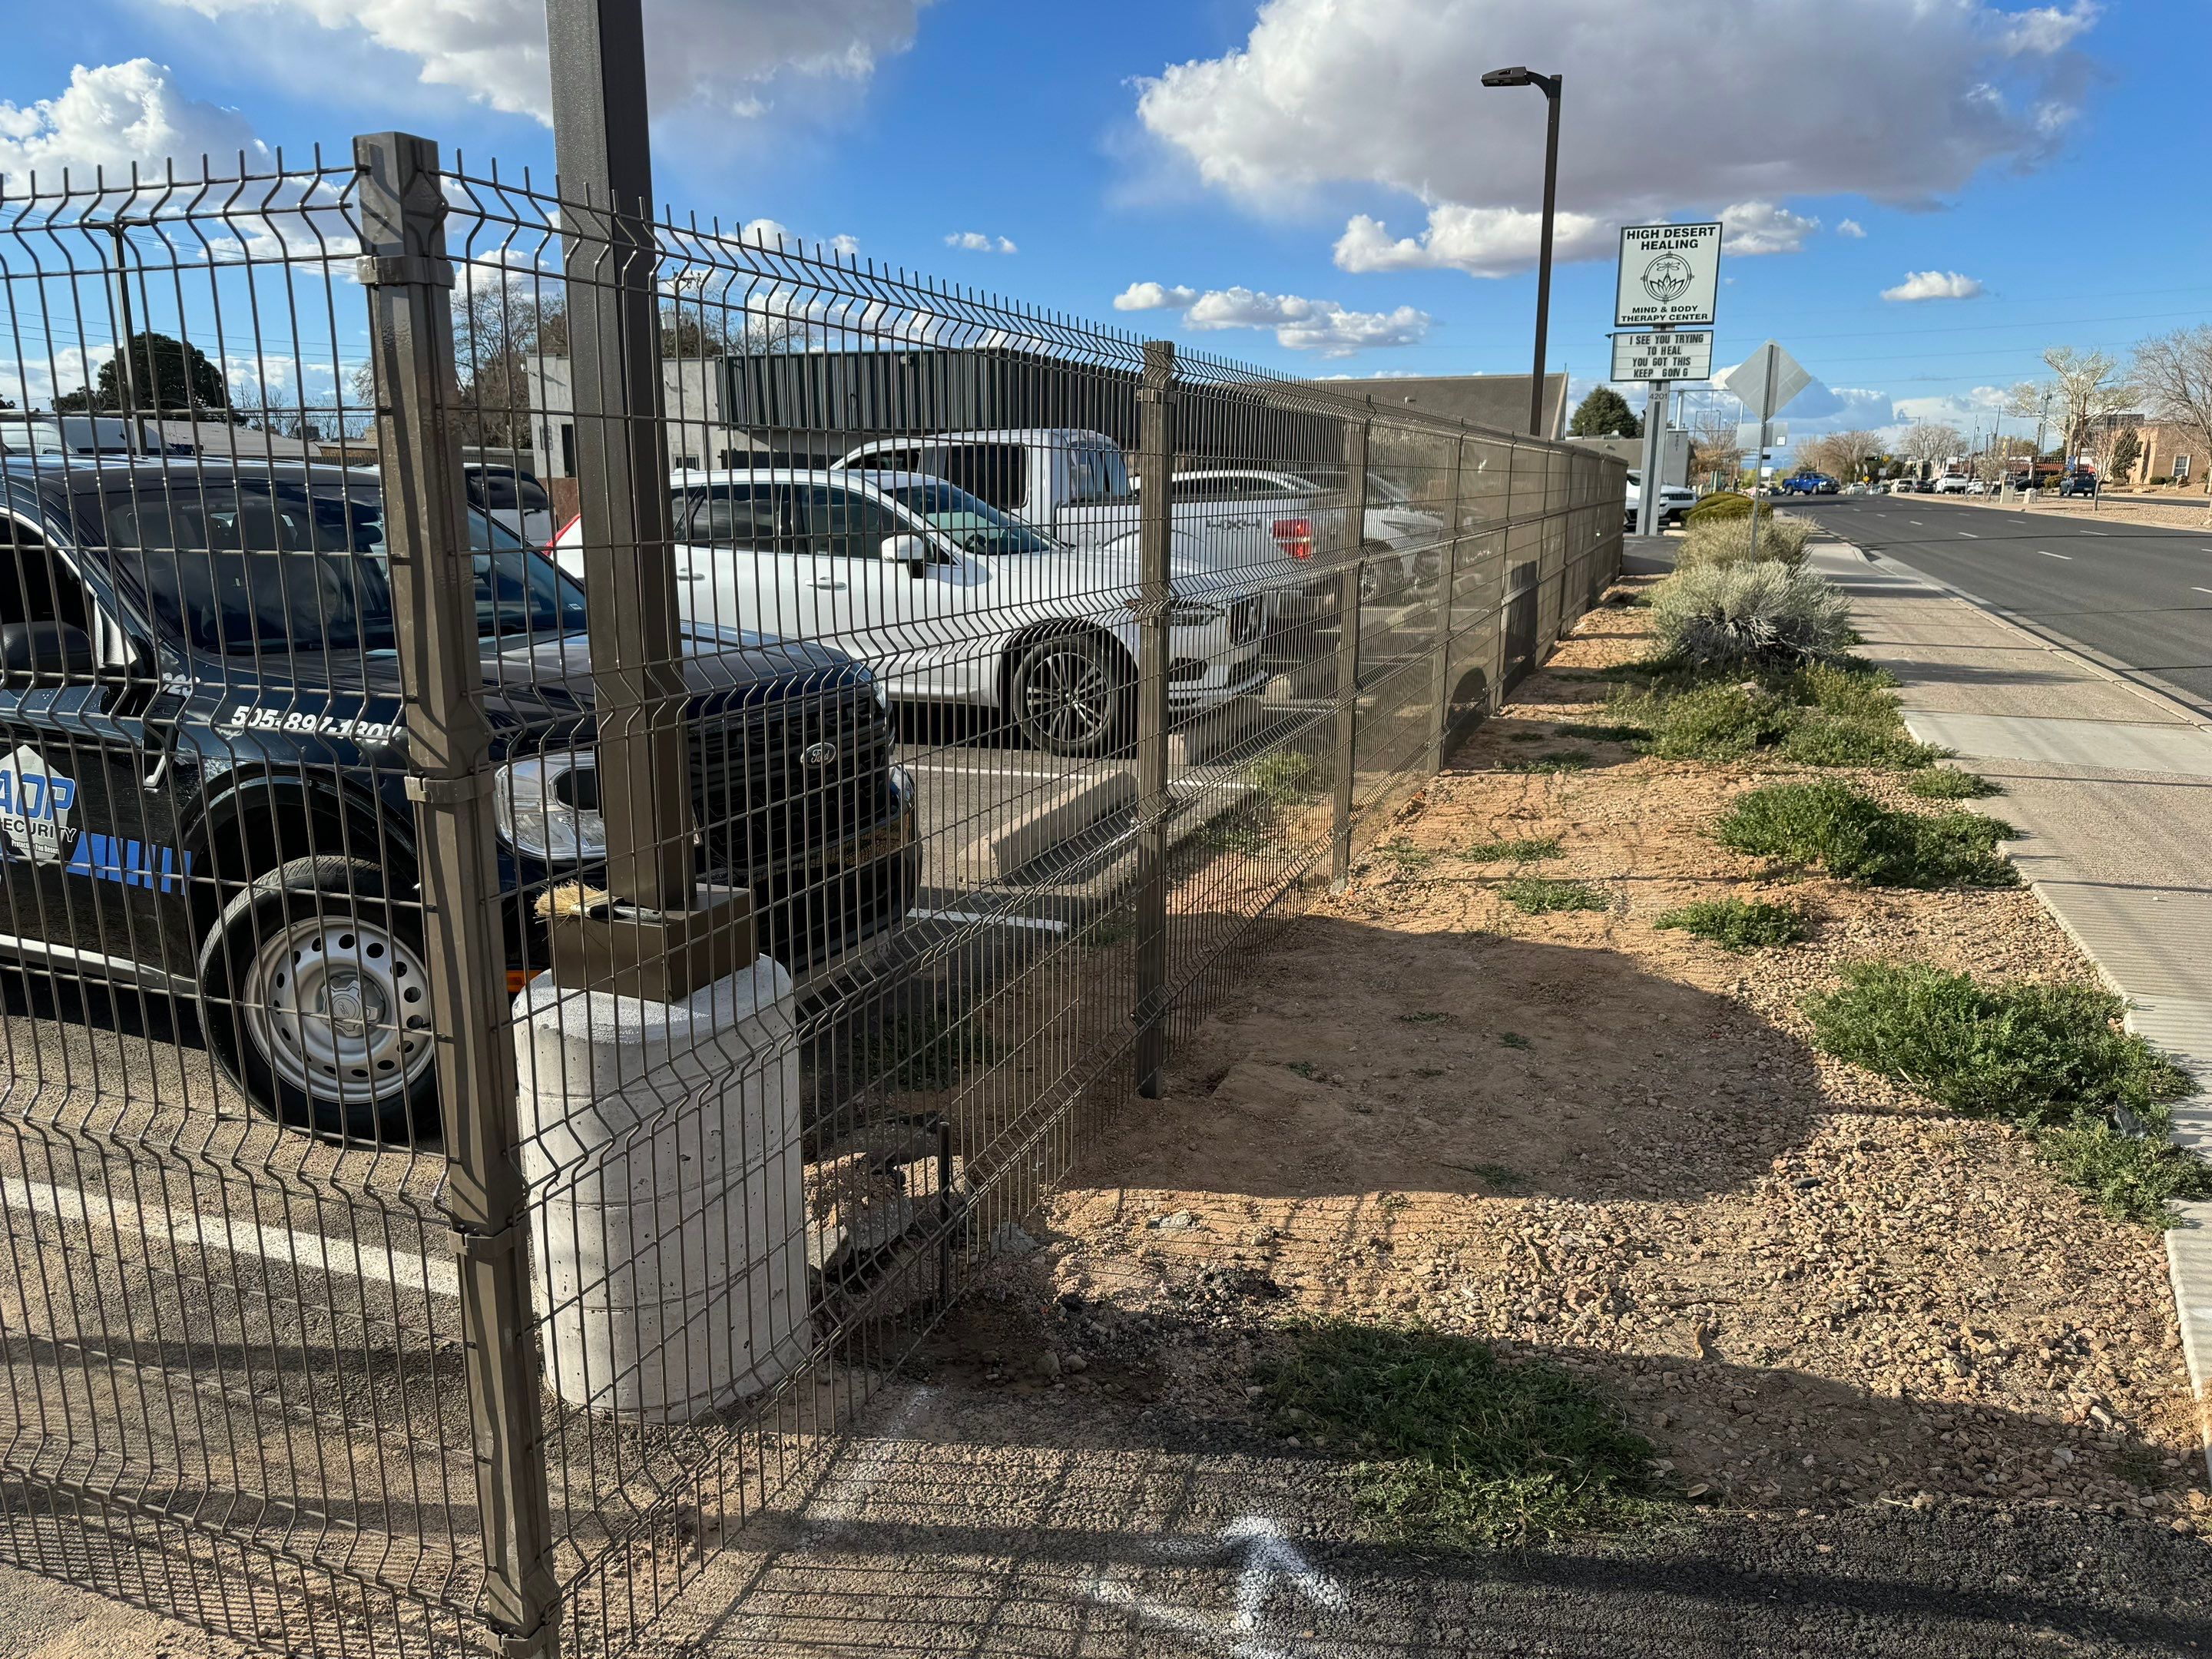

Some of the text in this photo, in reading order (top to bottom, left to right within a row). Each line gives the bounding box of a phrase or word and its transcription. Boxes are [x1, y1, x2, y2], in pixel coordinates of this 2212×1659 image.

[1627, 227, 1716, 240] HIGH DESERT
[1641, 240, 1699, 250] HEALING
[1629, 334, 1704, 346] I SEE YOU TRYING
[1647, 346, 1682, 356] TO HEAL
[1633, 356, 1691, 367] YOU GOT THIS
[1634, 369, 1654, 378] KEEP
[810, 749, 830, 763] Fod
[2, 816, 77, 843] ECURIY
